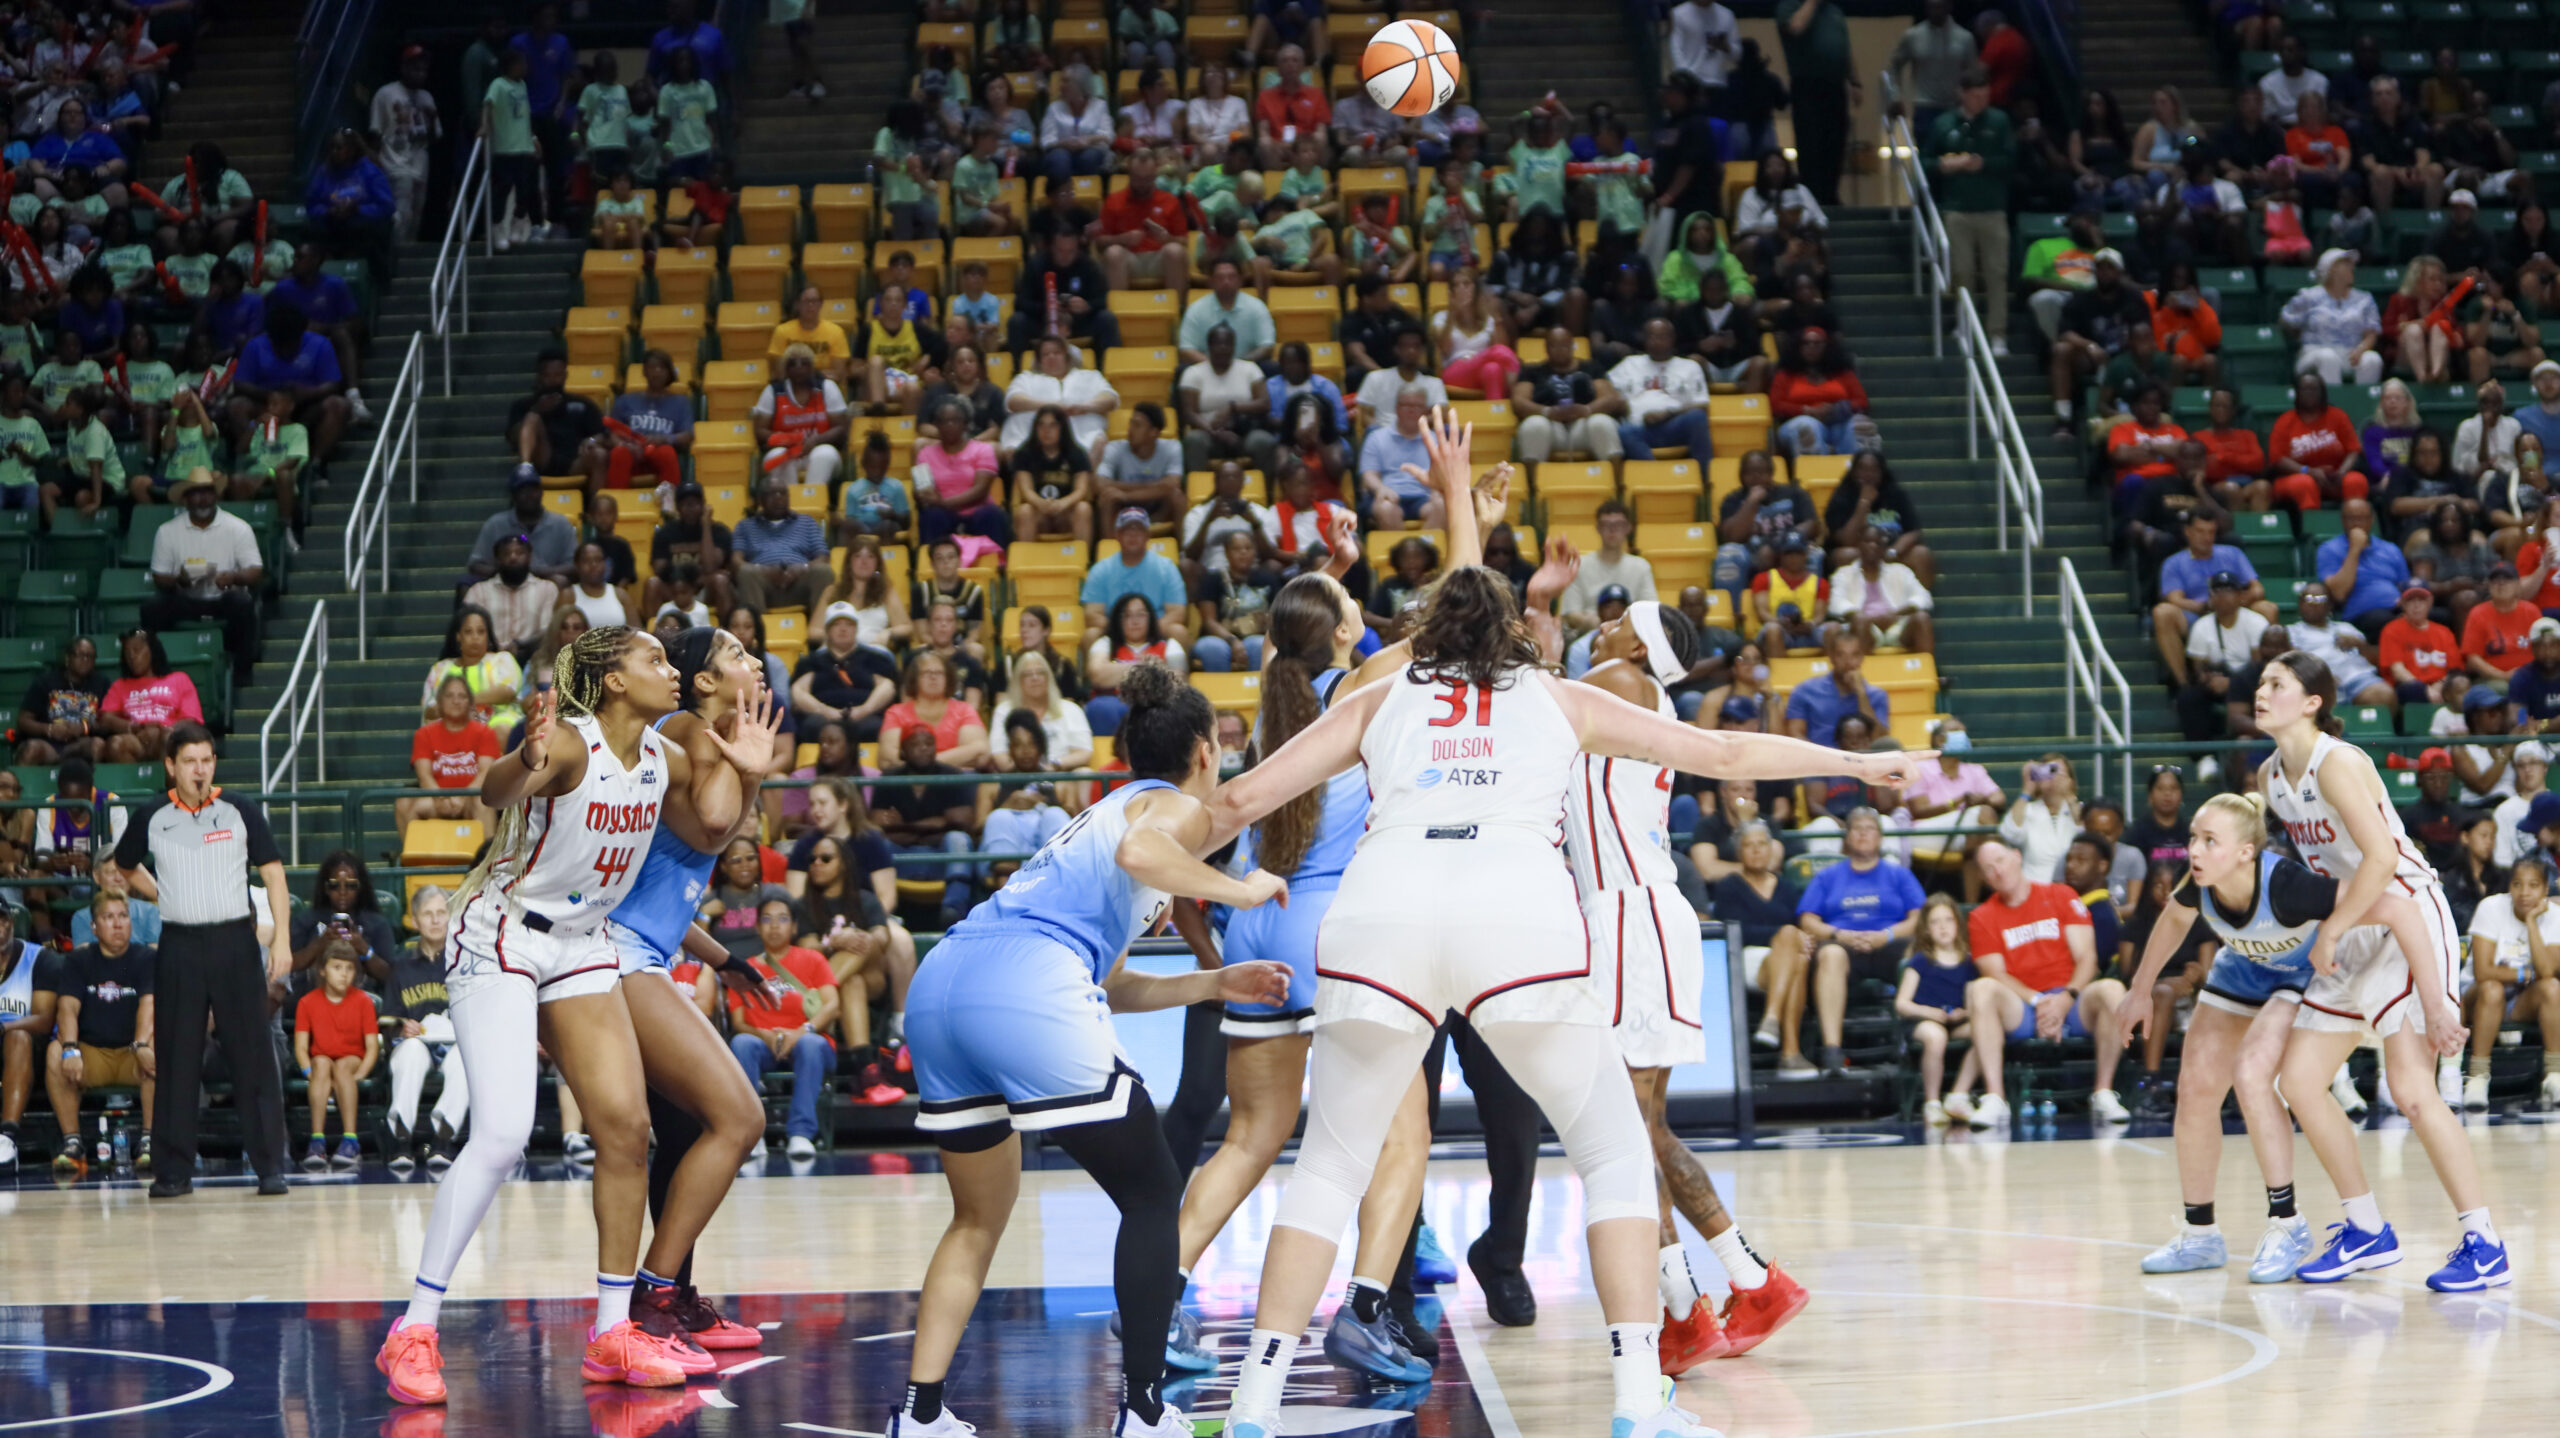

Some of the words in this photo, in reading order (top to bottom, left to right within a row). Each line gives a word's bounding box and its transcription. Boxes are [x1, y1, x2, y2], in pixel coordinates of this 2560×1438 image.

[1428, 674, 1493, 727] 31
[1432, 736, 1494, 762] DOLSON
[1447, 767, 1504, 786] AT&T
[593, 846, 636, 888] 44
